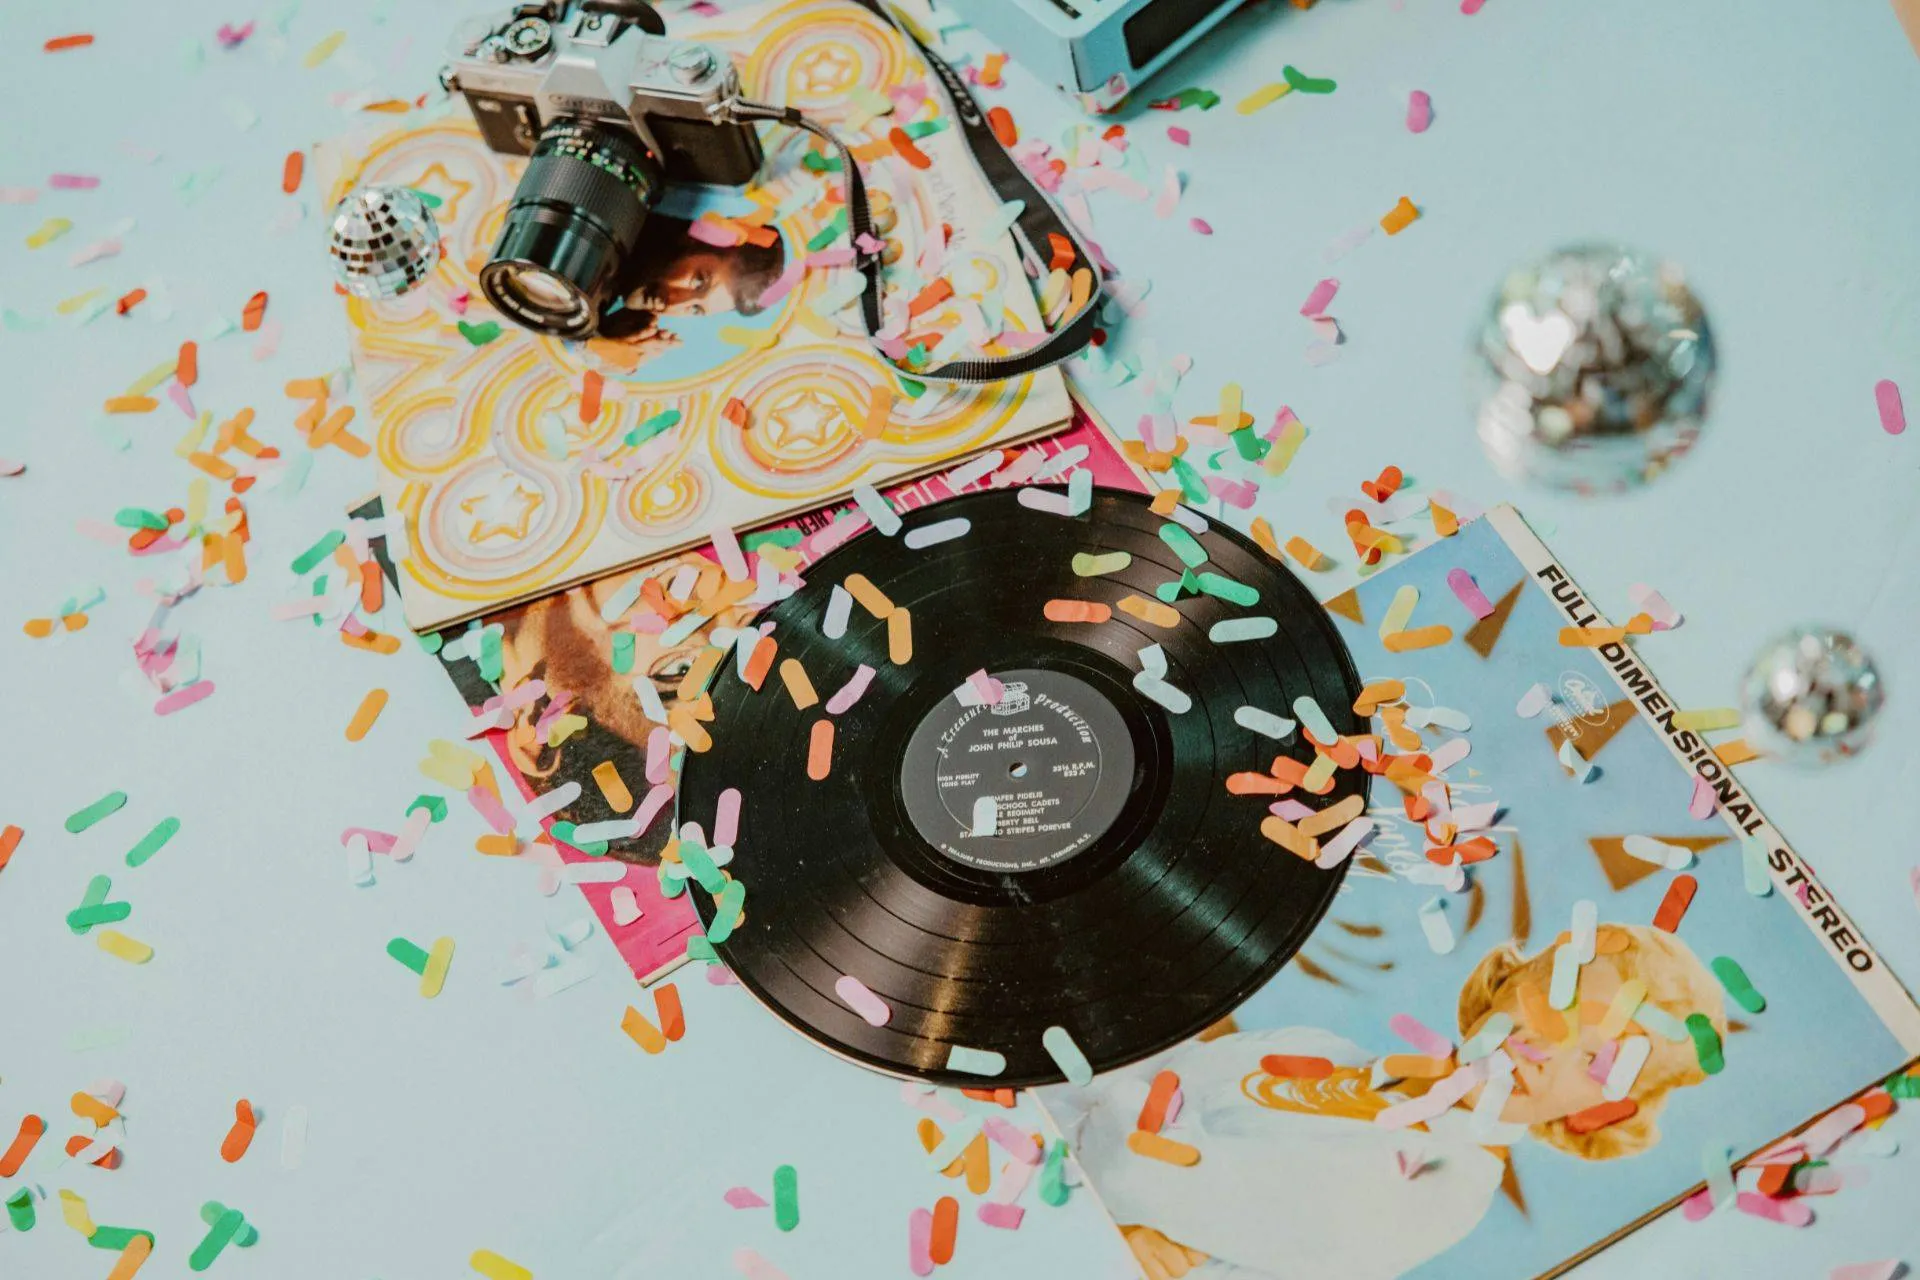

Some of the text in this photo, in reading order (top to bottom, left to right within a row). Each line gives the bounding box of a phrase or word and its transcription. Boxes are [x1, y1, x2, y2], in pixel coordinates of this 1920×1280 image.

[982, 723, 1044, 737] THE MARCHES
[1008, 733, 1018, 741] of
[968, 737, 1058, 753] JOHN PHILIP SOUSA
[1537, 564, 1873, 972] FULL DIMENSIONAL STEREO
[1017, 791, 1043, 800] FIDELIS
[997, 798, 1060, 810] SCHOOL CADETS
[1007, 807, 1045, 817] REGIMENT
[996, 817, 1040, 827] BERTY BELL
[1006, 825, 1035, 835] STRIPES
[1038, 822, 1071, 832] FOREVER
